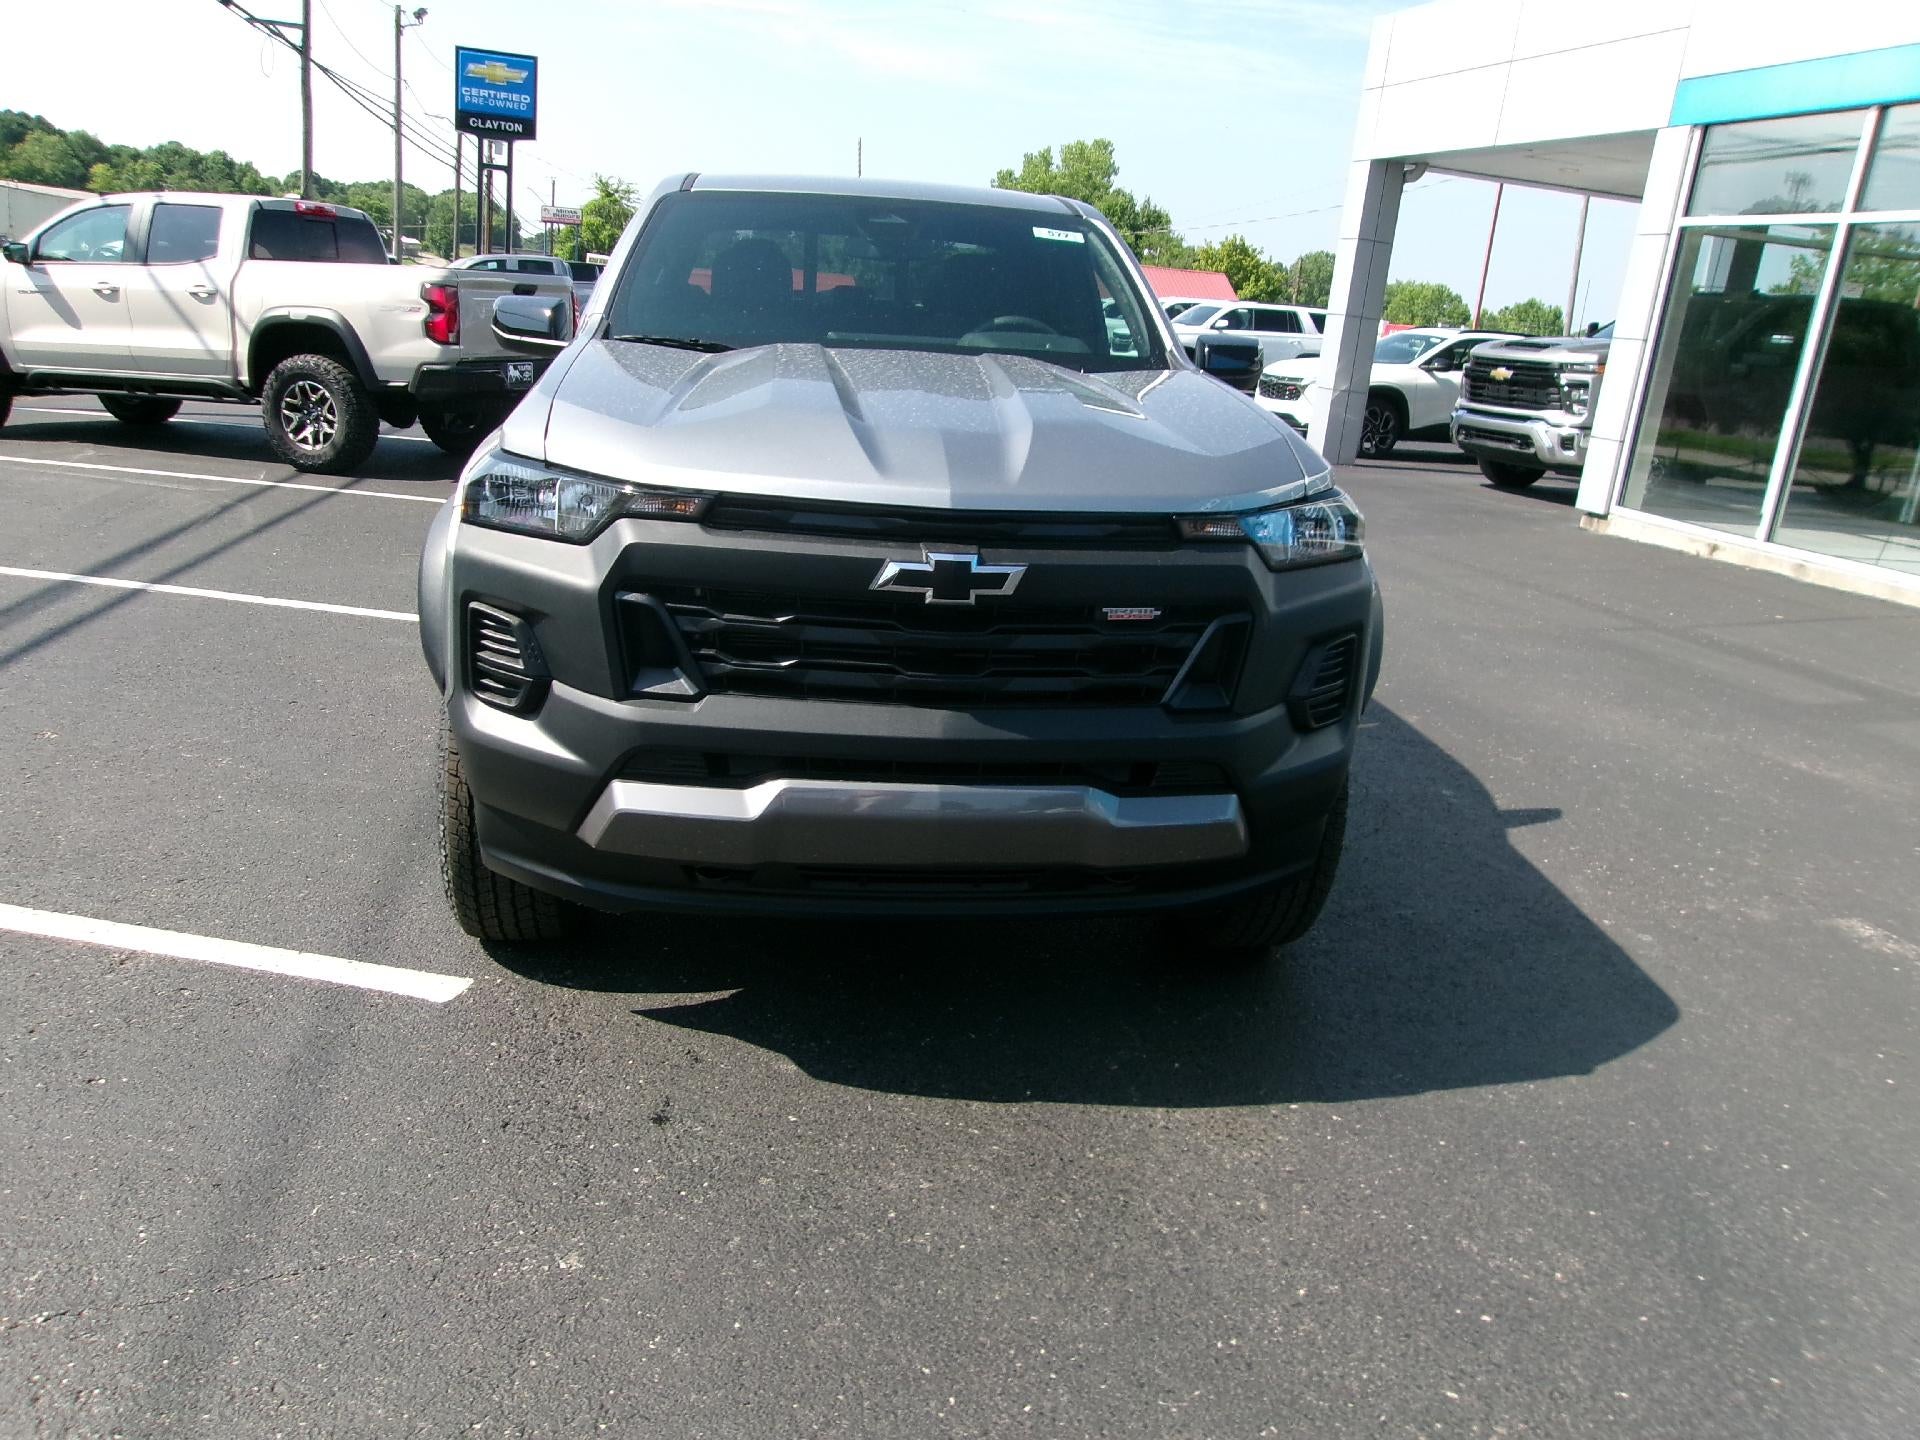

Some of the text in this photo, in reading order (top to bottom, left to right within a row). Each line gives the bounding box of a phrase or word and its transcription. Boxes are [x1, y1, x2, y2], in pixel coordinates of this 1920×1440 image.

[462, 87, 531, 103] CERTIFIED
[465, 95, 527, 111] PRE-OWNED
[469, 117, 523, 133] CLAYTON
